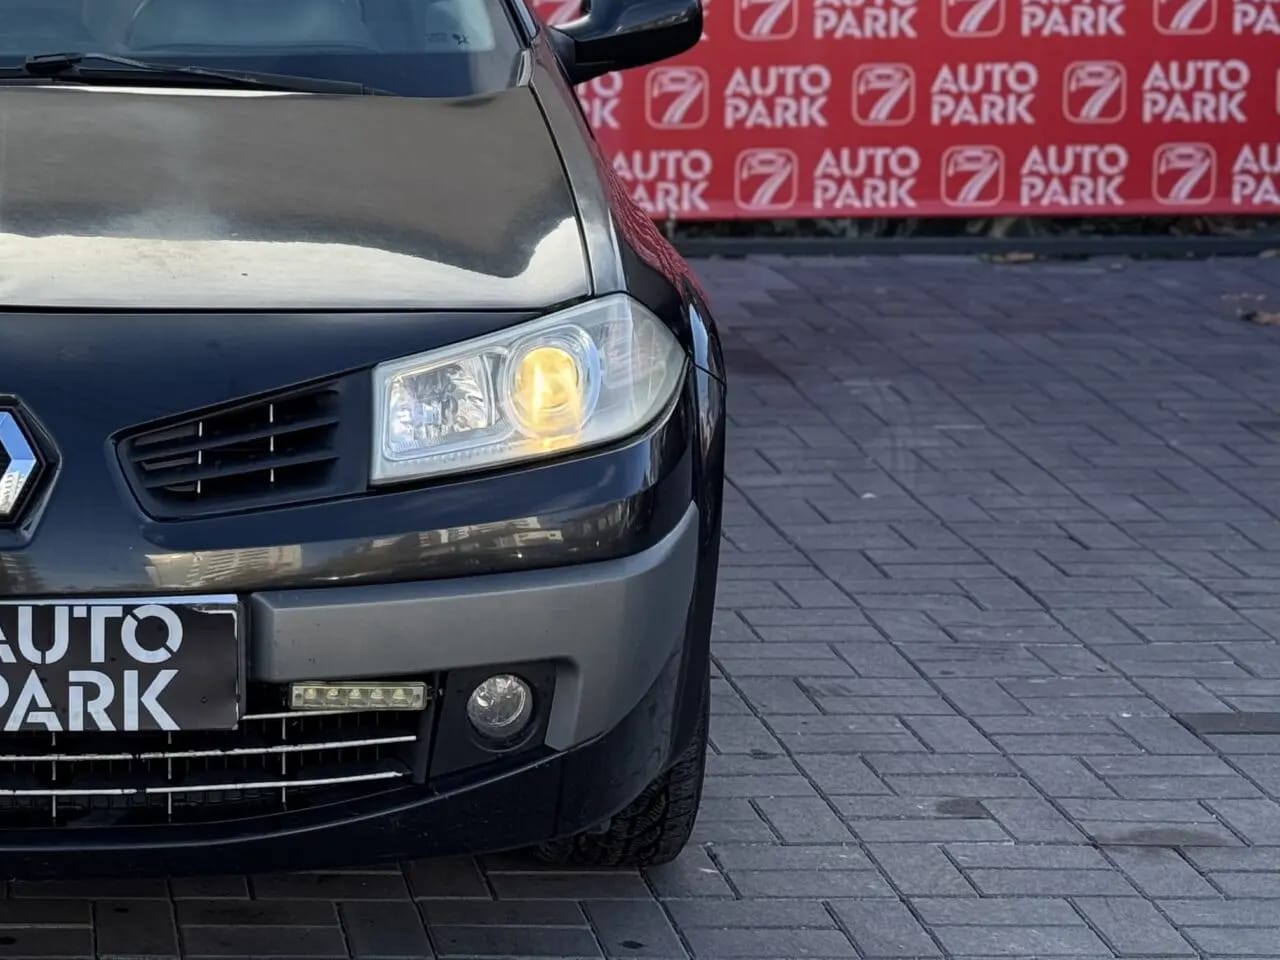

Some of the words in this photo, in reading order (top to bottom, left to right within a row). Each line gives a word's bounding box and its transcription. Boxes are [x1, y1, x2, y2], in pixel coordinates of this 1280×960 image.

[814, 8, 917, 38] PARK
[1022, 5, 1125, 36] PARK
[725, 65, 831, 96] AUTO
[1142, 59, 1250, 90] AUTO
[725, 97, 827, 127] PARK
[1143, 91, 1246, 122] PARK
[814, 147, 919, 177] AUTO
[1021, 144, 1128, 175] AUTO
[813, 178, 918, 210] PARK
[1020, 176, 1125, 207] PARK
